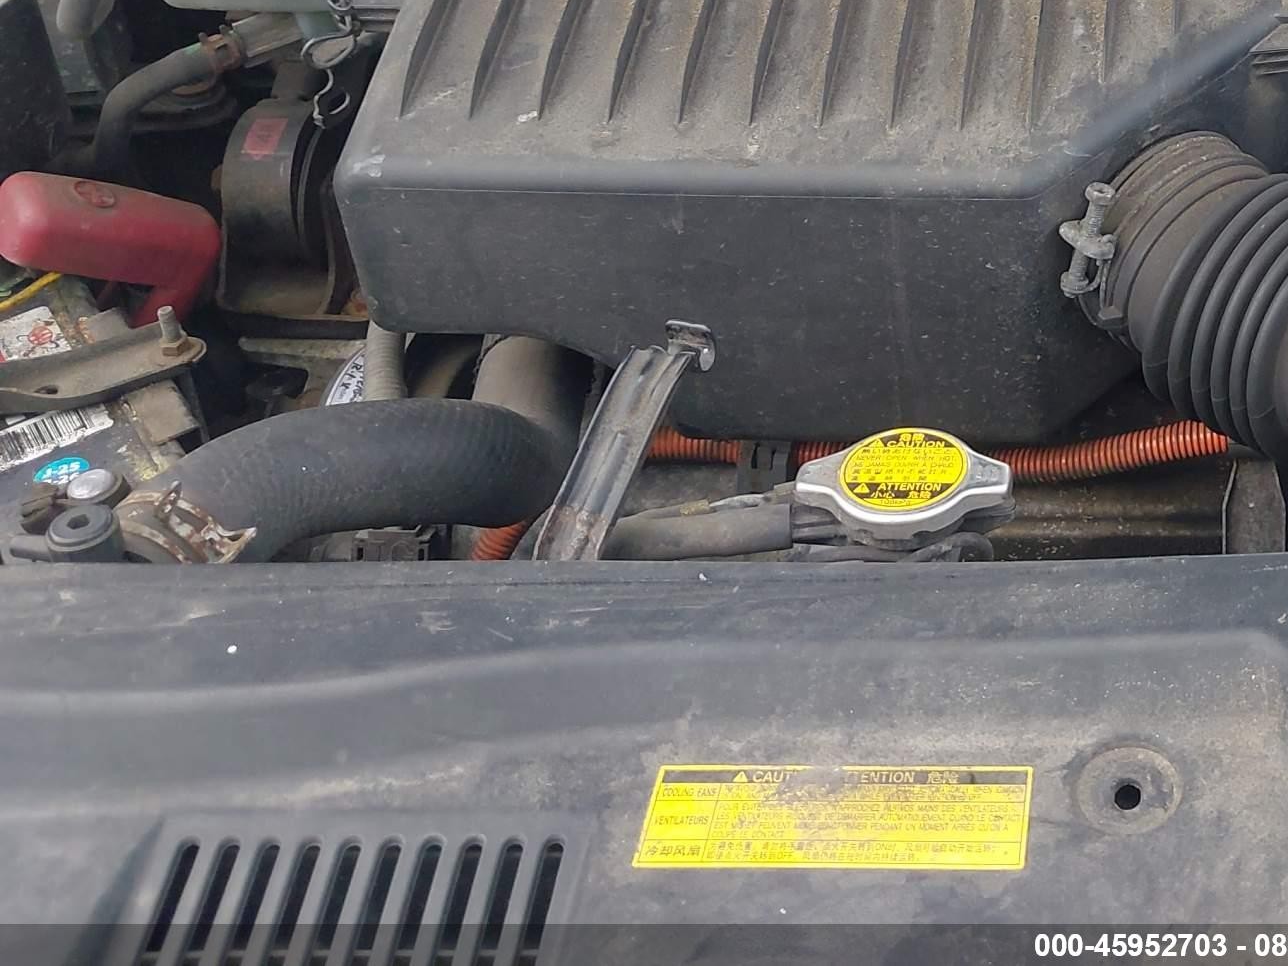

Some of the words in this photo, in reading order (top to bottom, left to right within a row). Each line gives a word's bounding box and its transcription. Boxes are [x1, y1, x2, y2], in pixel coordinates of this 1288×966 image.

[886, 440, 945, 448] CAUTION
[877, 482, 942, 491] ATTENTION
[870, 490, 896, 499] 小心
[661, 787, 695, 797] COOLING
[697, 787, 718, 797] FANS
[654, 815, 708, 825] VENTILATEURS
